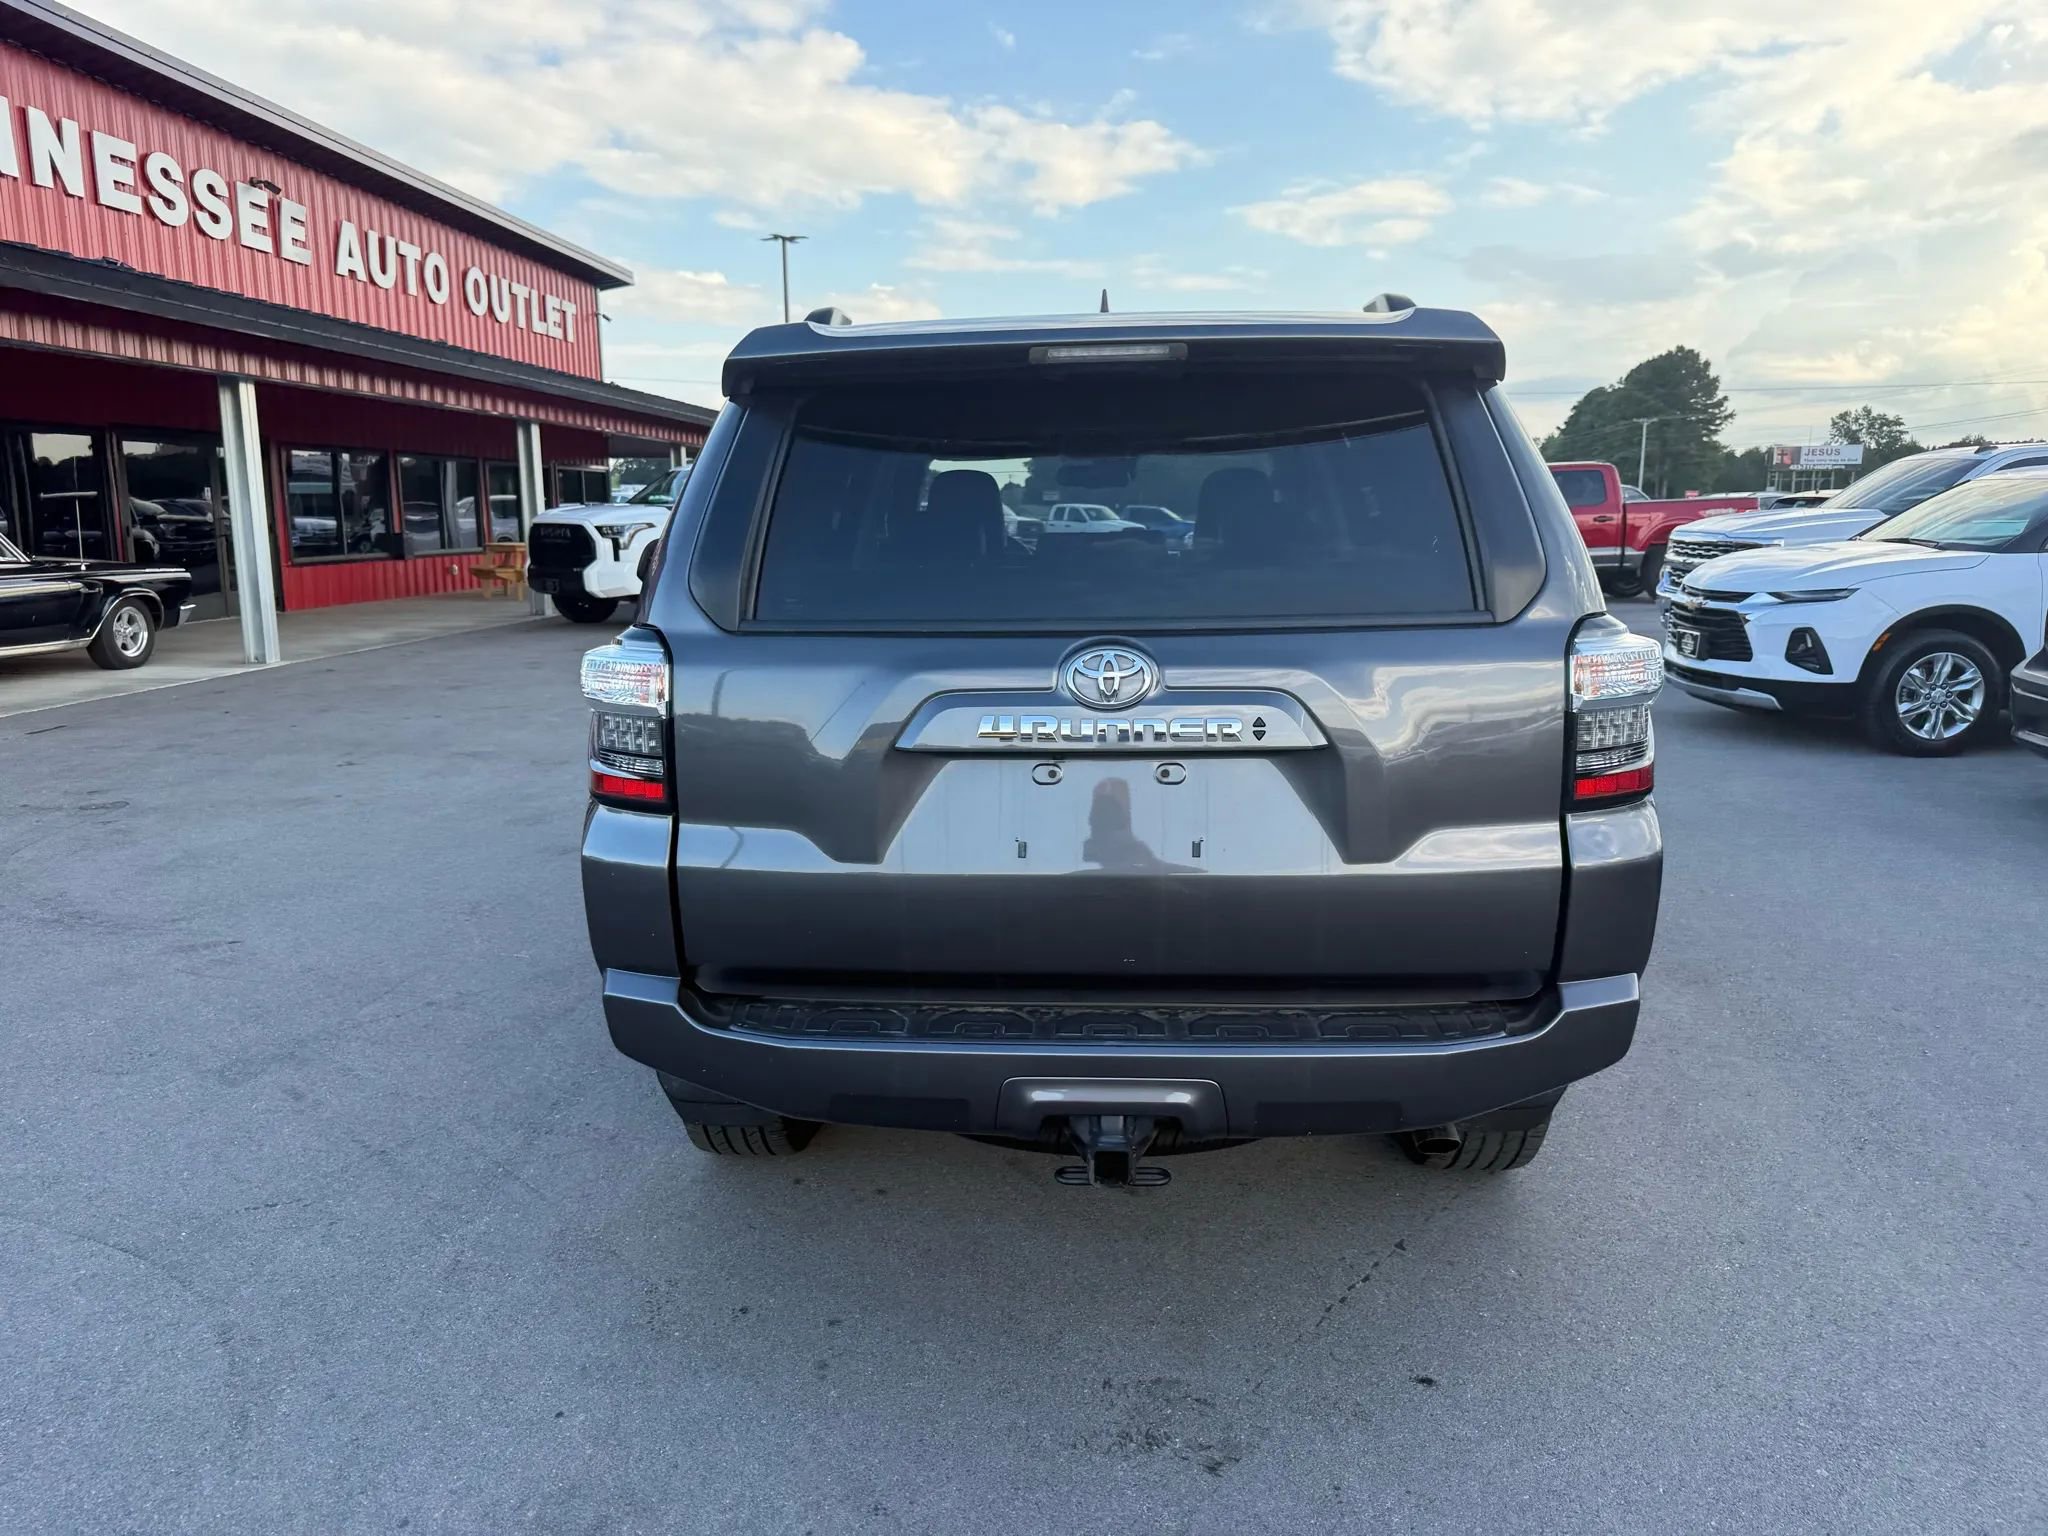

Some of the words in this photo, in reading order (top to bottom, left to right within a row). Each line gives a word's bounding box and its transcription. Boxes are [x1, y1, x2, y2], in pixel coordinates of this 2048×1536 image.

[336, 220, 448, 305] AUTO
[464, 266, 577, 343] OUTLET
[1804, 448, 1841, 456] JESUS
